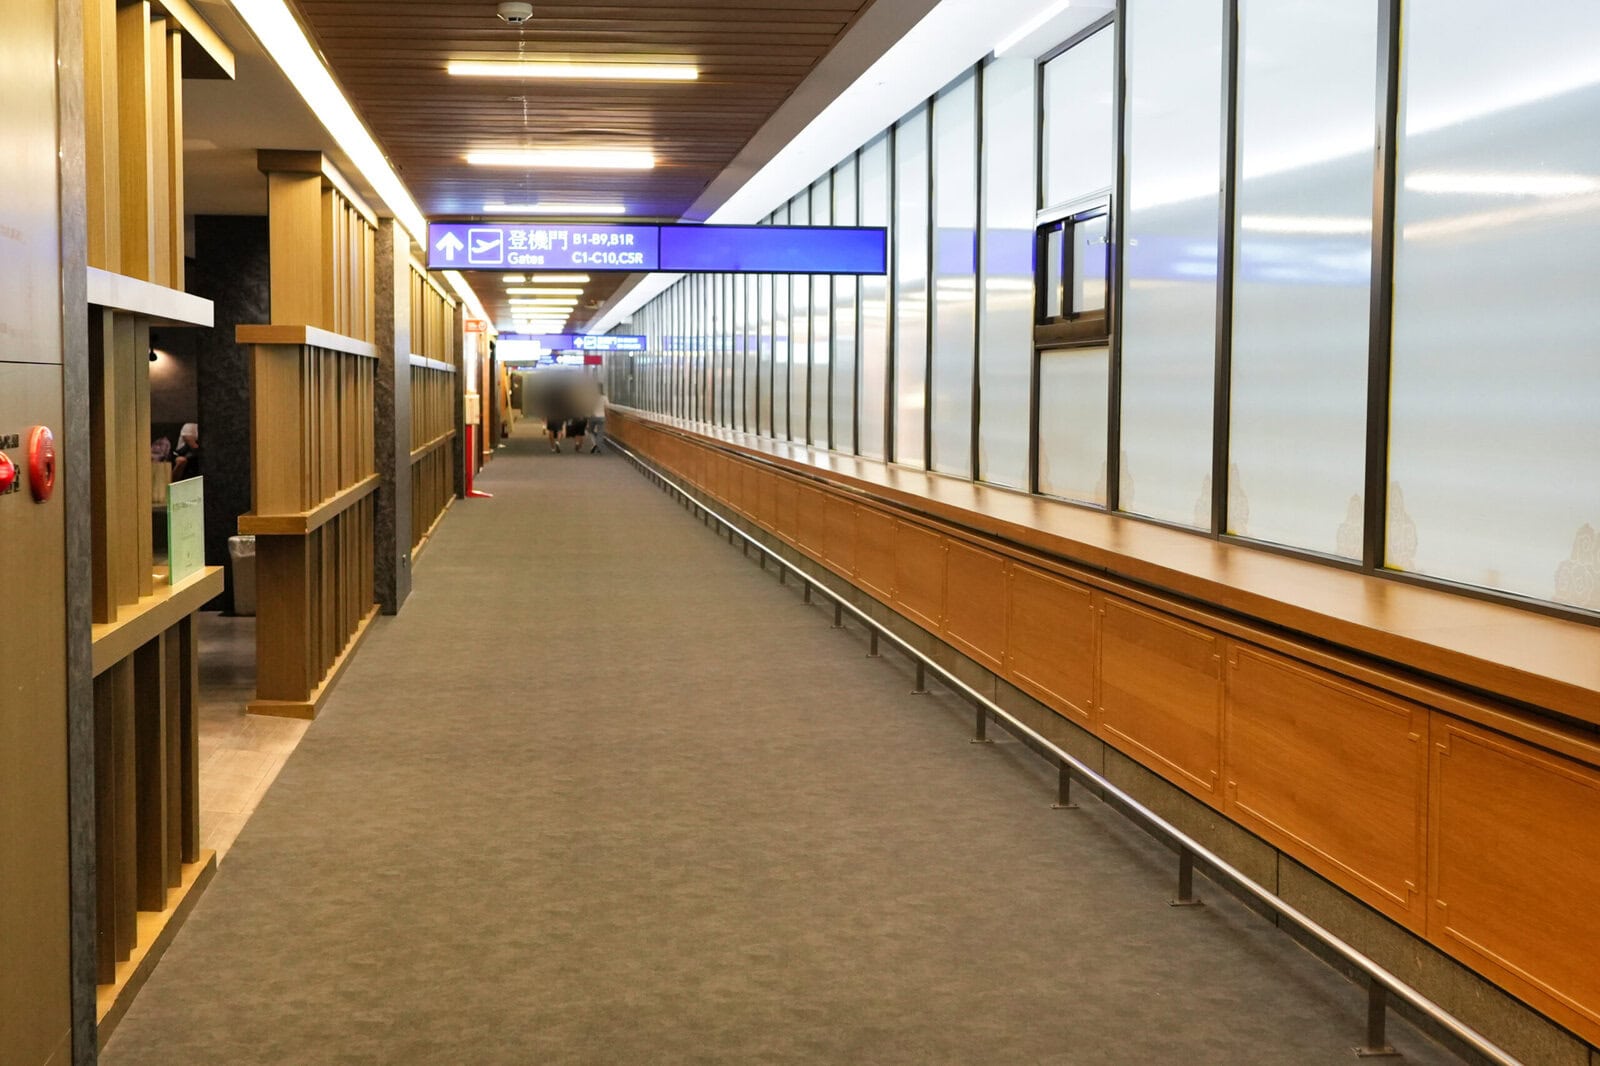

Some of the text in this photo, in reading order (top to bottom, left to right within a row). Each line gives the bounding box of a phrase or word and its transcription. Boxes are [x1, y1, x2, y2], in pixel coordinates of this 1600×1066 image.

[508, 230, 568, 250] 登機門
[572, 233, 634, 246] B1-B9,B1R
[507, 252, 545, 265] Gates
[571, 252, 643, 265] C1-C10,C5R
